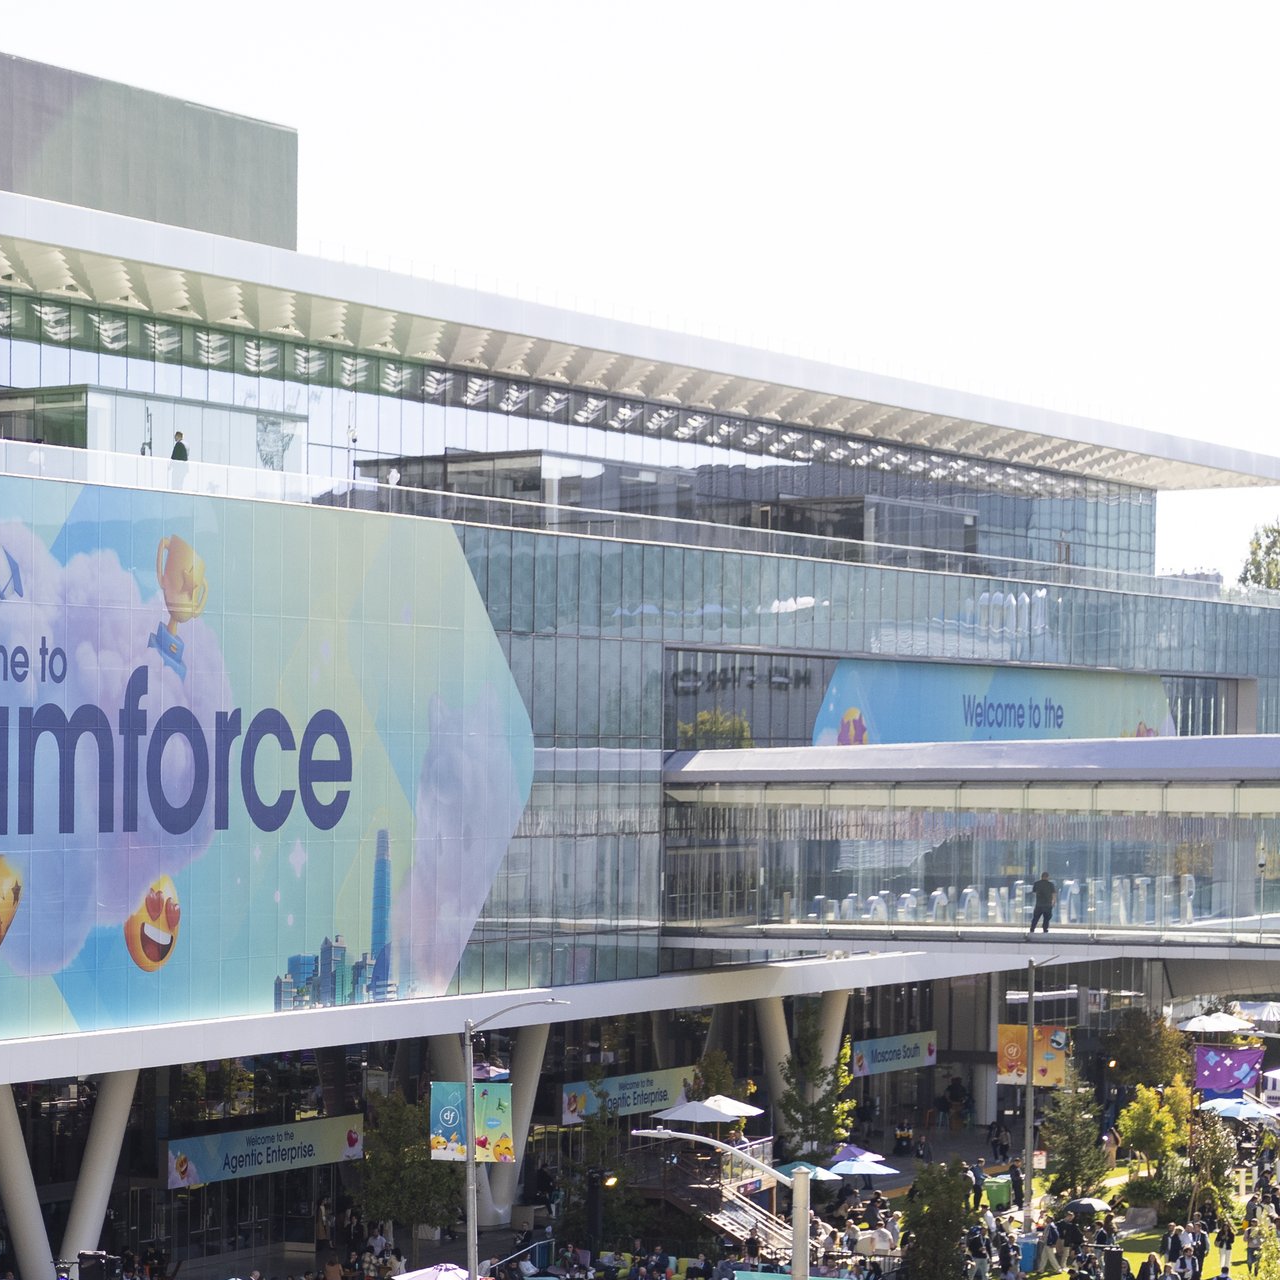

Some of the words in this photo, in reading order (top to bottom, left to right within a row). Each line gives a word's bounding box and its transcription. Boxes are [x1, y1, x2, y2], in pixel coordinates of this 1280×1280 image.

[40, 635, 68, 685] to
[962, 694, 1025, 729] Welcome
[1028, 696, 1041, 729] to
[1044, 697, 1064, 729] the
[871, 1046, 901, 1065] Moscone
[902, 1043, 921, 1061] South
[607, 1092, 631, 1112] gentic
[443, 1110, 456, 1124] df
[246, 1134, 276, 1147] Welcome
[277, 1131, 284, 1143] to
[284, 1130, 295, 1141] the
[222, 1148, 263, 1174] Agentic
